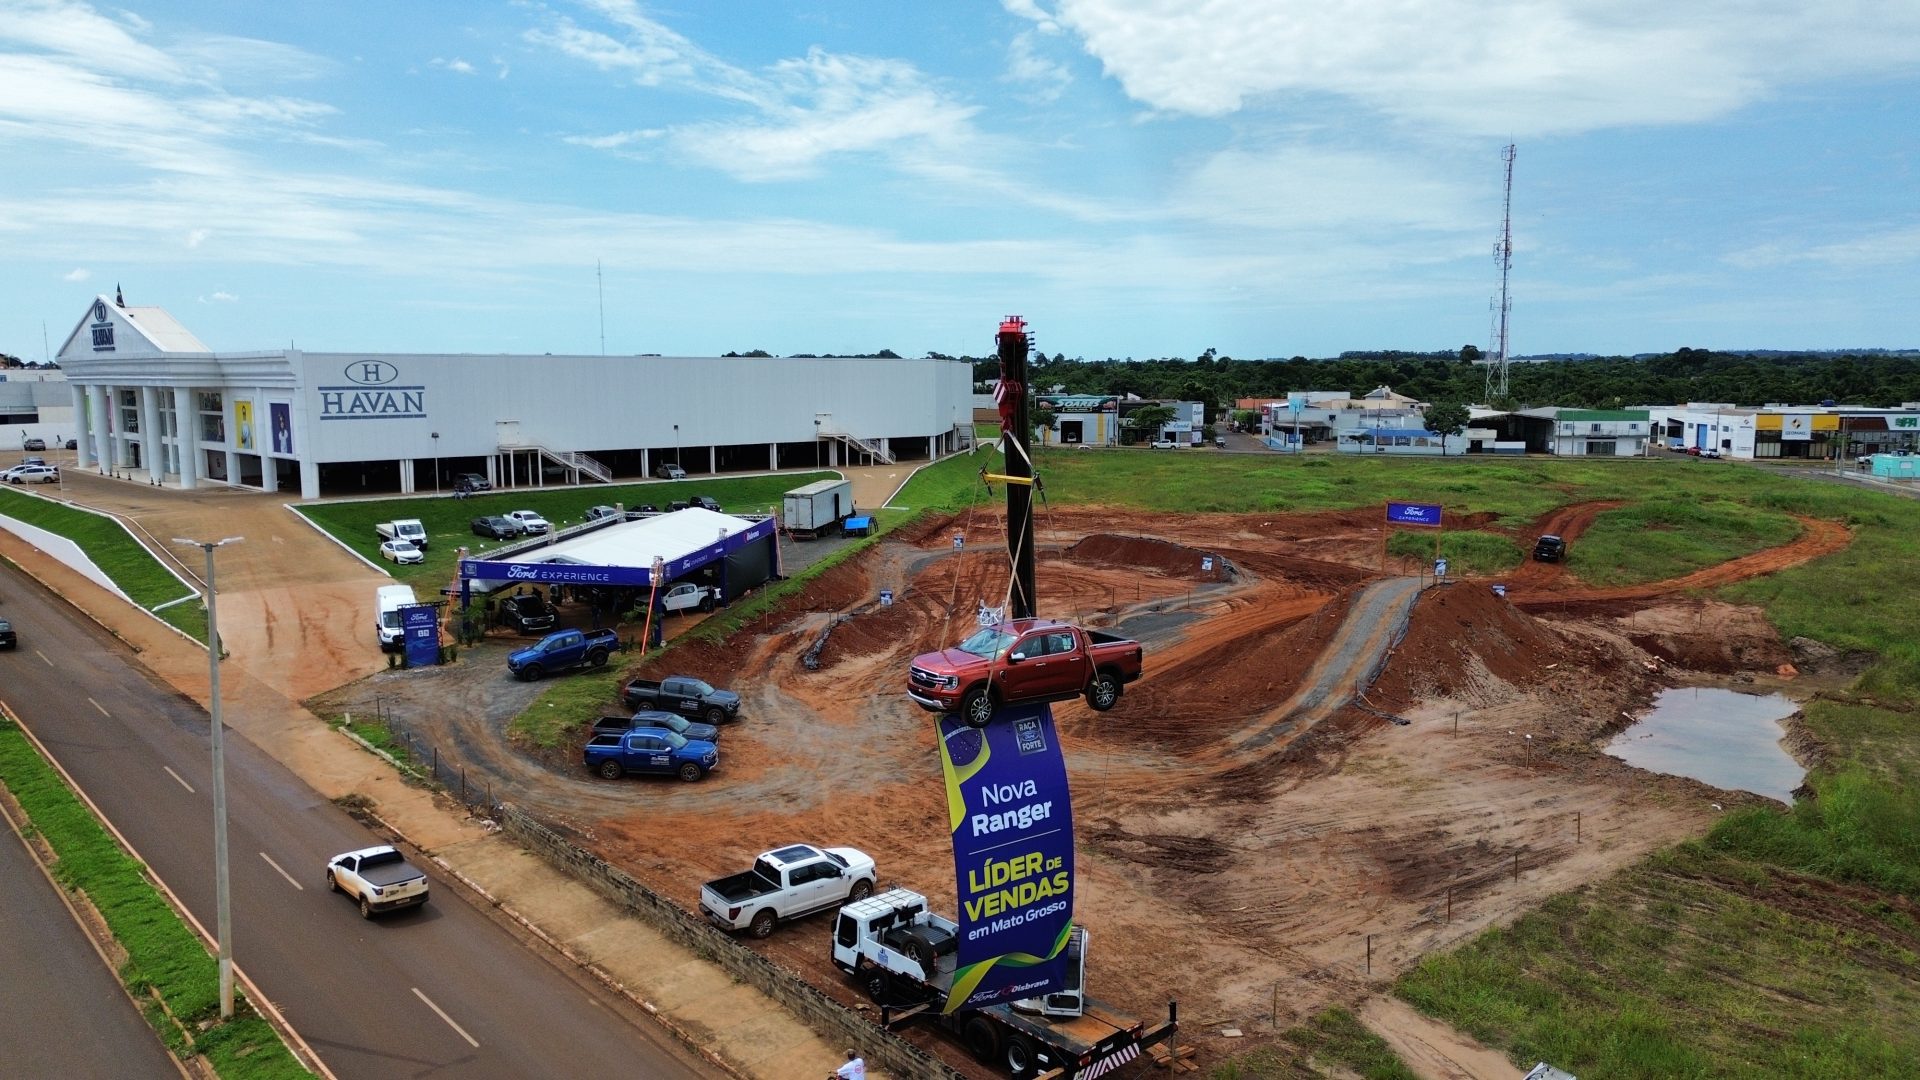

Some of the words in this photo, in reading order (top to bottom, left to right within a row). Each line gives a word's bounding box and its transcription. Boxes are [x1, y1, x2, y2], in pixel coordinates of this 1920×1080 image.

[362, 364, 381, 381] H
[320, 392, 424, 414] HAVAN
[1404, 506, 1425, 516] Ford
[507, 564, 538, 579] Ford
[541, 572, 610, 582] EXPERIENCE
[410, 613, 428, 621] Ford
[1018, 721, 1036, 732] RAÇA
[1022, 740, 1042, 751] FORTE
[982, 780, 1038, 808] Nova
[972, 800, 1052, 837] Ranger
[969, 852, 1044, 894] LÍDER
[1046, 856, 1062, 871] DE
[964, 872, 1069, 922] VENDAS
[968, 926, 989, 940] em
[991, 915, 1024, 934] Mato
[1025, 900, 1066, 922] Grosso
[968, 990, 1001, 1004] Ford
[1011, 978, 1049, 992] Disbrava
